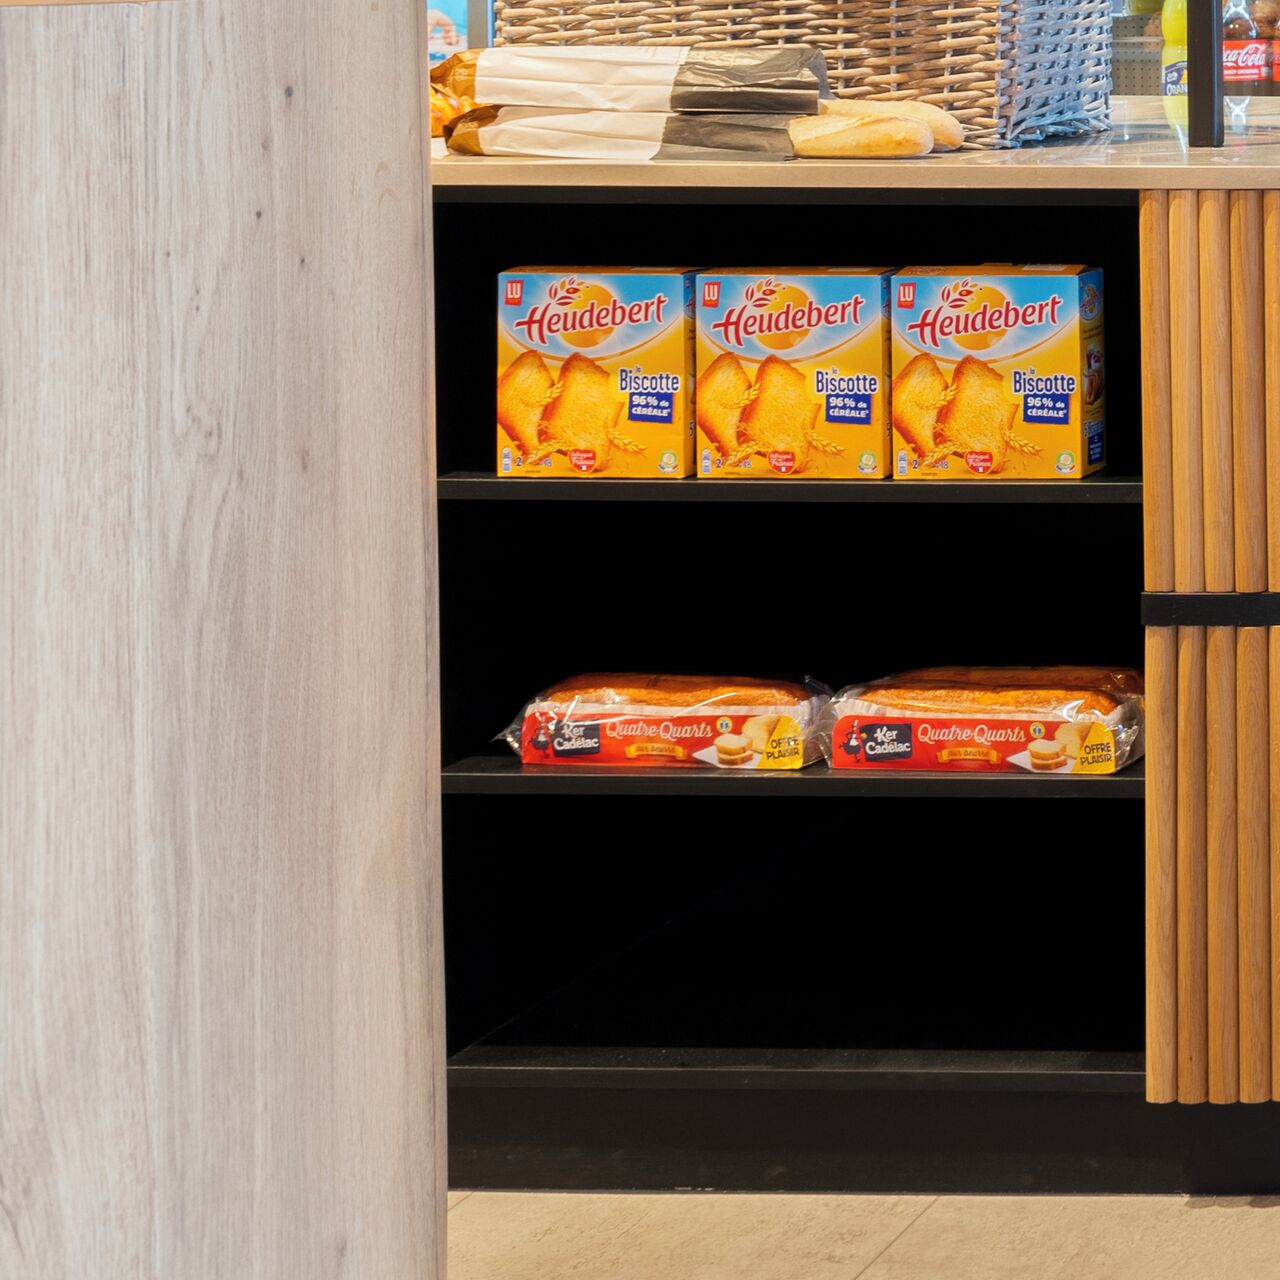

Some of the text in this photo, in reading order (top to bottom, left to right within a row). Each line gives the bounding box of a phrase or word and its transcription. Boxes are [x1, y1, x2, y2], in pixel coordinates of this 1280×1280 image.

[507, 282, 521, 298] LU
[704, 284, 718, 300] LU
[899, 284, 913, 301] LU
[515, 294, 667, 344] Heudebert
[712, 295, 865, 347] Heudebert
[908, 295, 1062, 347] Heudebert
[620, 369, 679, 391] Biscotte
[816, 371, 877, 393] Biscotte
[1013, 371, 1075, 393] Biscotte
[632, 395, 657, 406] 96%
[829, 397, 855, 407] 96%
[1027, 398, 1053, 407] 96%
[562, 724, 584, 738] Ker
[876, 725, 897, 743] Ker
[554, 736, 599, 750] Cadélac
[866, 739, 910, 754] Cadélac
[1084, 743, 1111, 755] OFFRE
[766, 748, 800, 760] PLAISIR
[1080, 754, 1112, 765] PLAISIR
